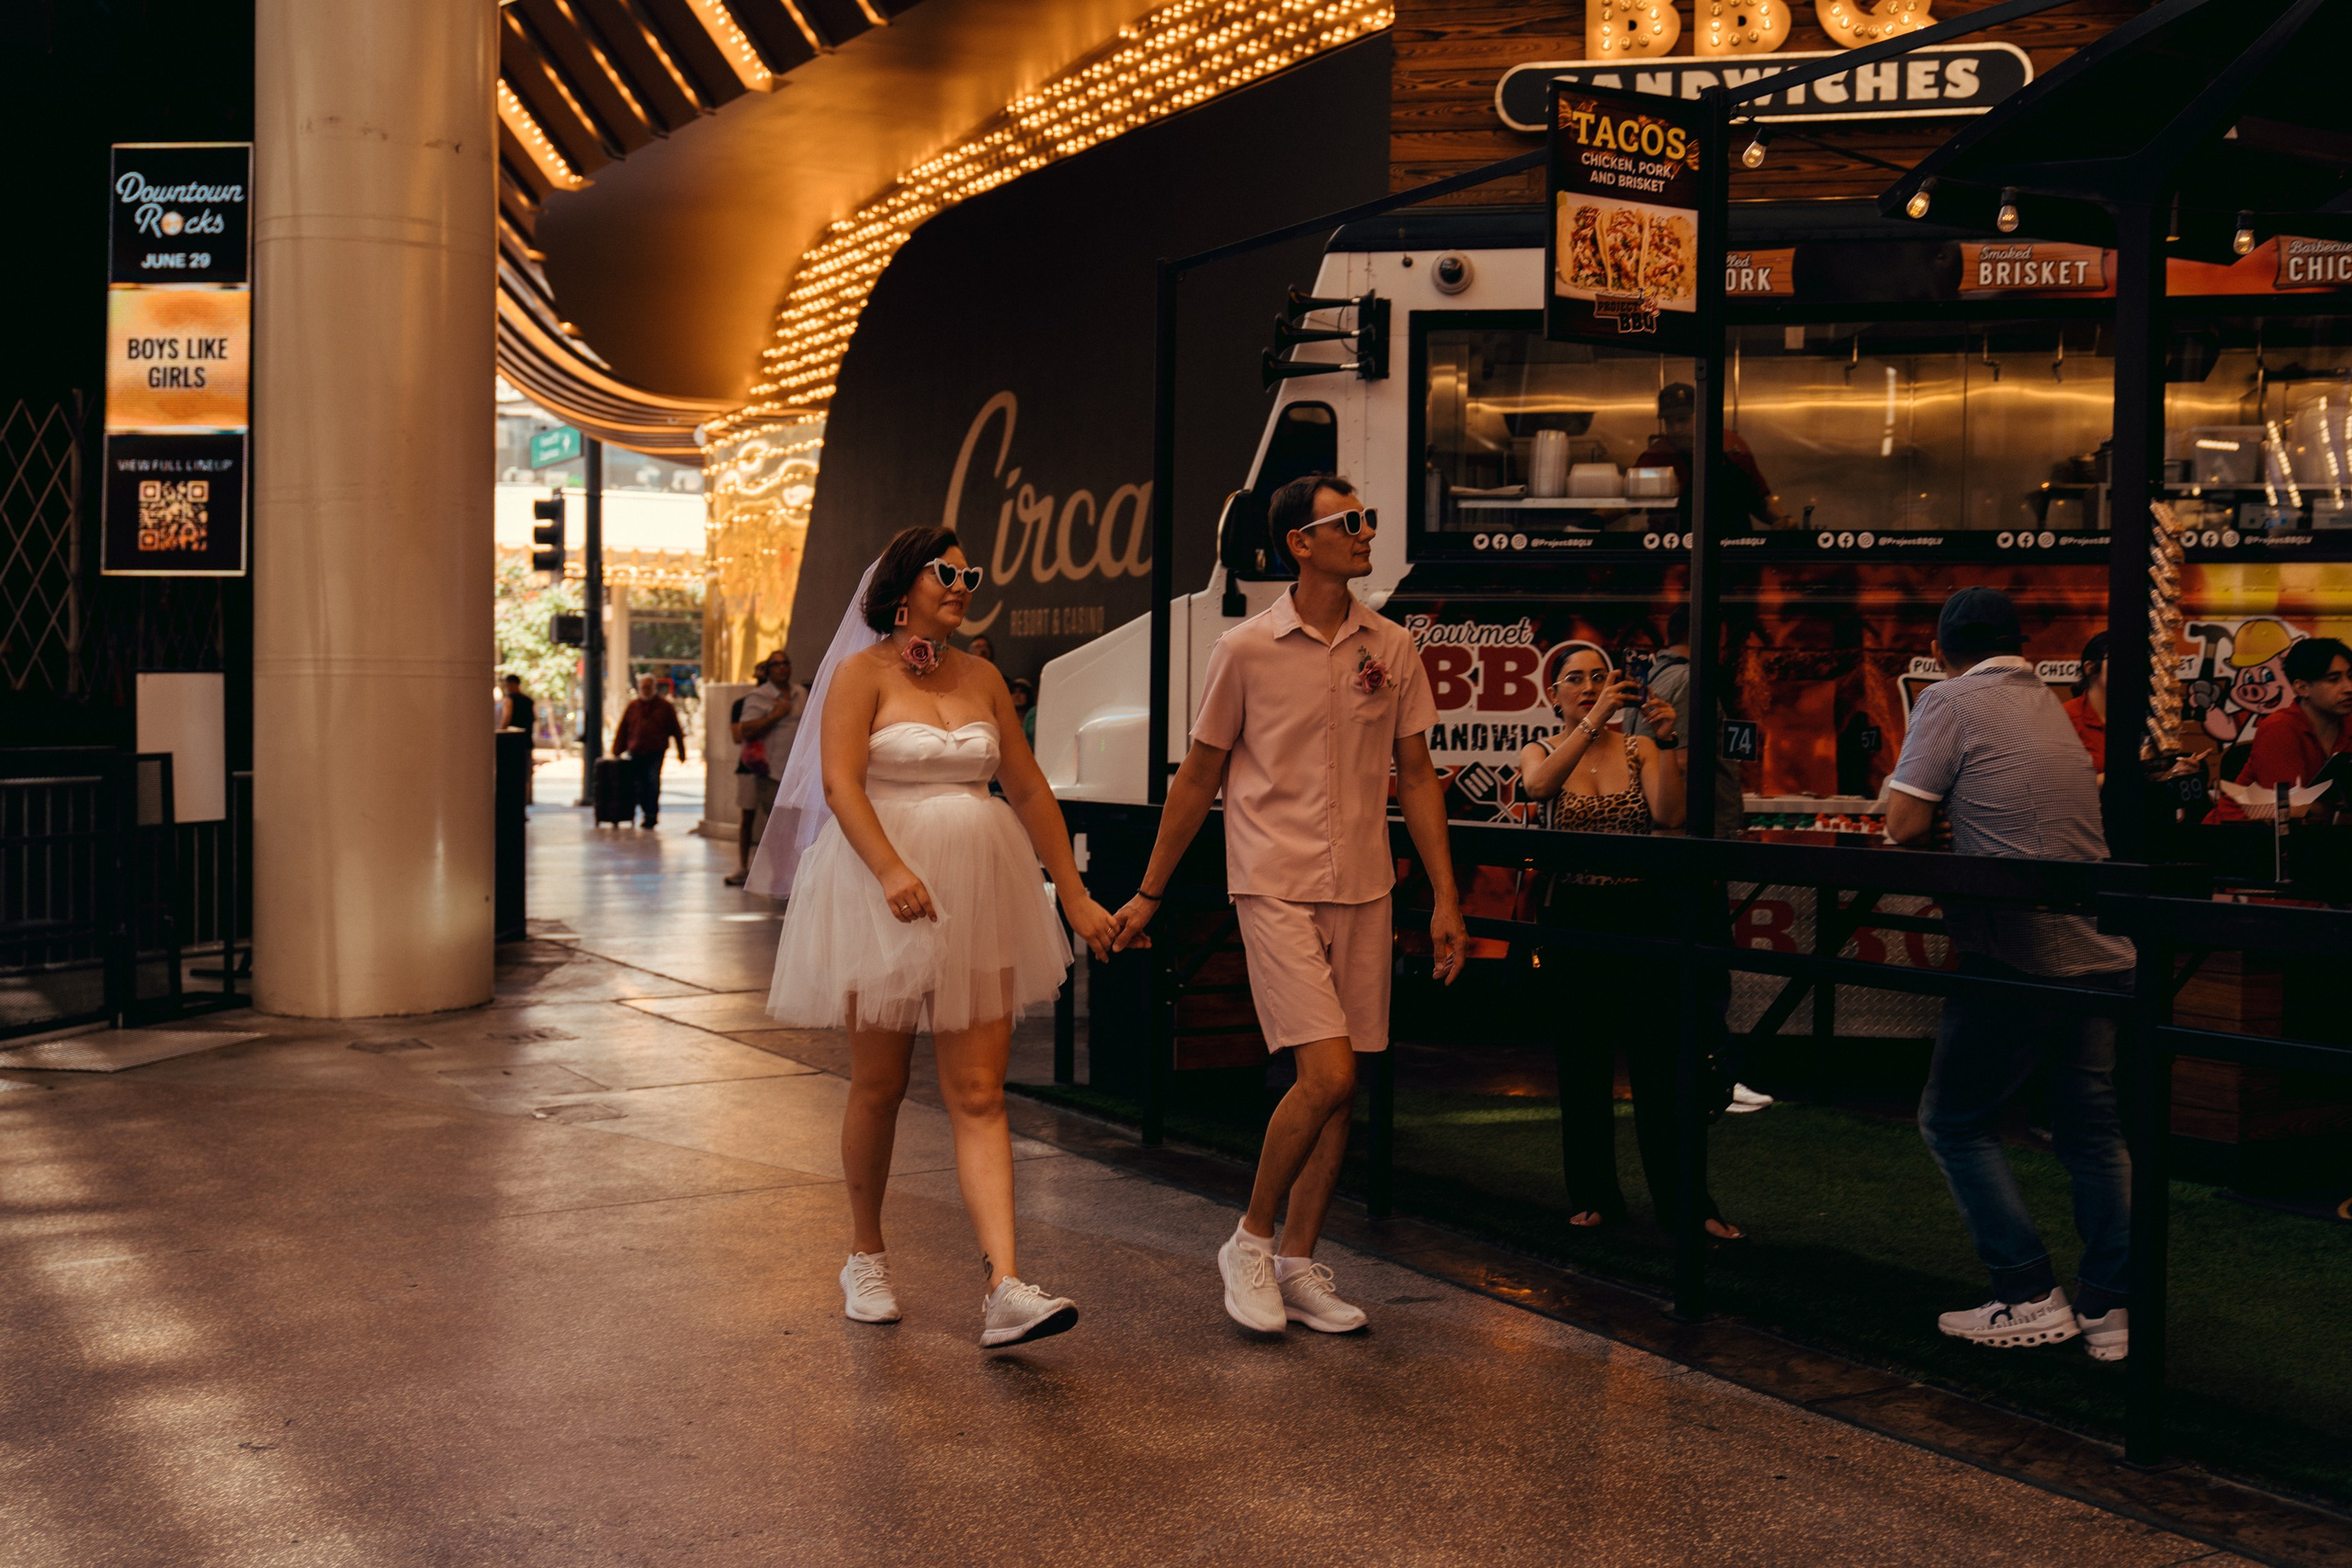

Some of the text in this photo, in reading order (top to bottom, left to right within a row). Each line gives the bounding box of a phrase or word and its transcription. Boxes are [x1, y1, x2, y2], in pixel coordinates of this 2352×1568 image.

[1547, 58, 1981, 107] NDWICHES
[1572, 110, 1687, 160] TACOS
[1581, 152, 1675, 181] CHICKEN, PORK,
[115, 171, 244, 203] Downtown
[1589, 170, 1666, 193] AND BRISKET
[141, 253, 211, 269] JUNE 29
[1980, 244, 2033, 261] Smoked
[1979, 261, 2089, 286] BRISKET
[1620, 310, 1655, 331] BBQ
[128, 338, 228, 359] BOYS LIKE
[149, 367, 206, 388] GIRLS
[116, 459, 233, 471] VIEW FULL LINEUP
[942, 389, 1153, 636] Circa
[1011, 608, 1049, 636] RESORT
[1063, 605, 1104, 635] CASINO
[1408, 615, 1532, 649] Gourmet
[1727, 726, 1752, 754] 74
[2179, 778, 2202, 801] 89
